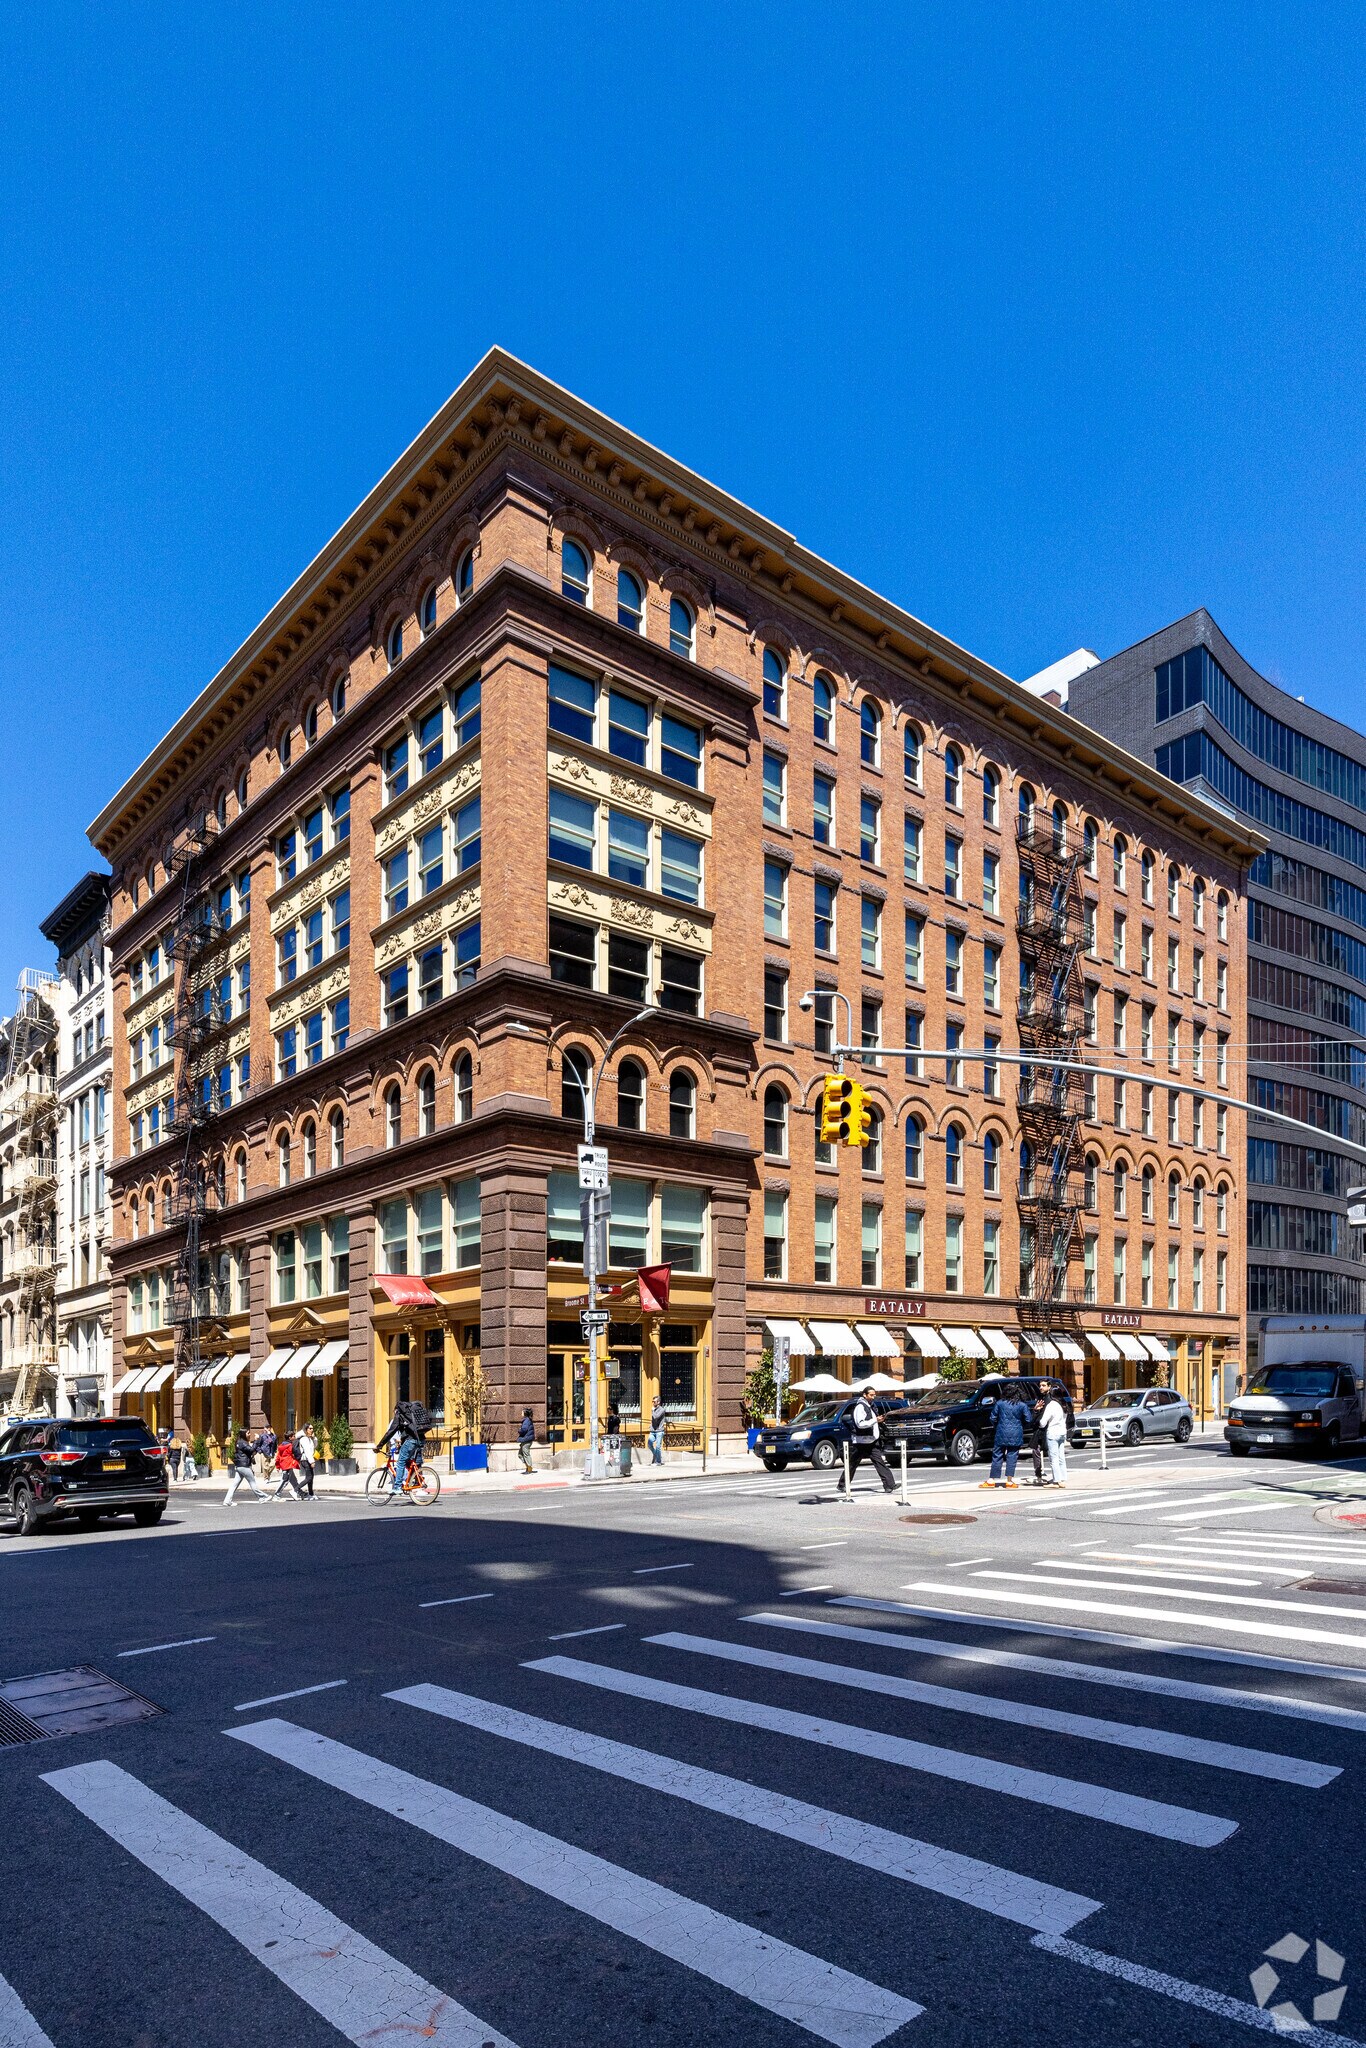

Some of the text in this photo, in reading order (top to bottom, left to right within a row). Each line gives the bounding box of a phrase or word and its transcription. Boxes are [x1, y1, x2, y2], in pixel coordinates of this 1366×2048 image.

[594, 1161, 607, 1169] ROUTE
[392, 1291, 432, 1300] EATAL
[564, 1299, 579, 1307] Broome
[870, 1300, 923, 1314] EATALY
[1105, 1314, 1140, 1325] EATALY
